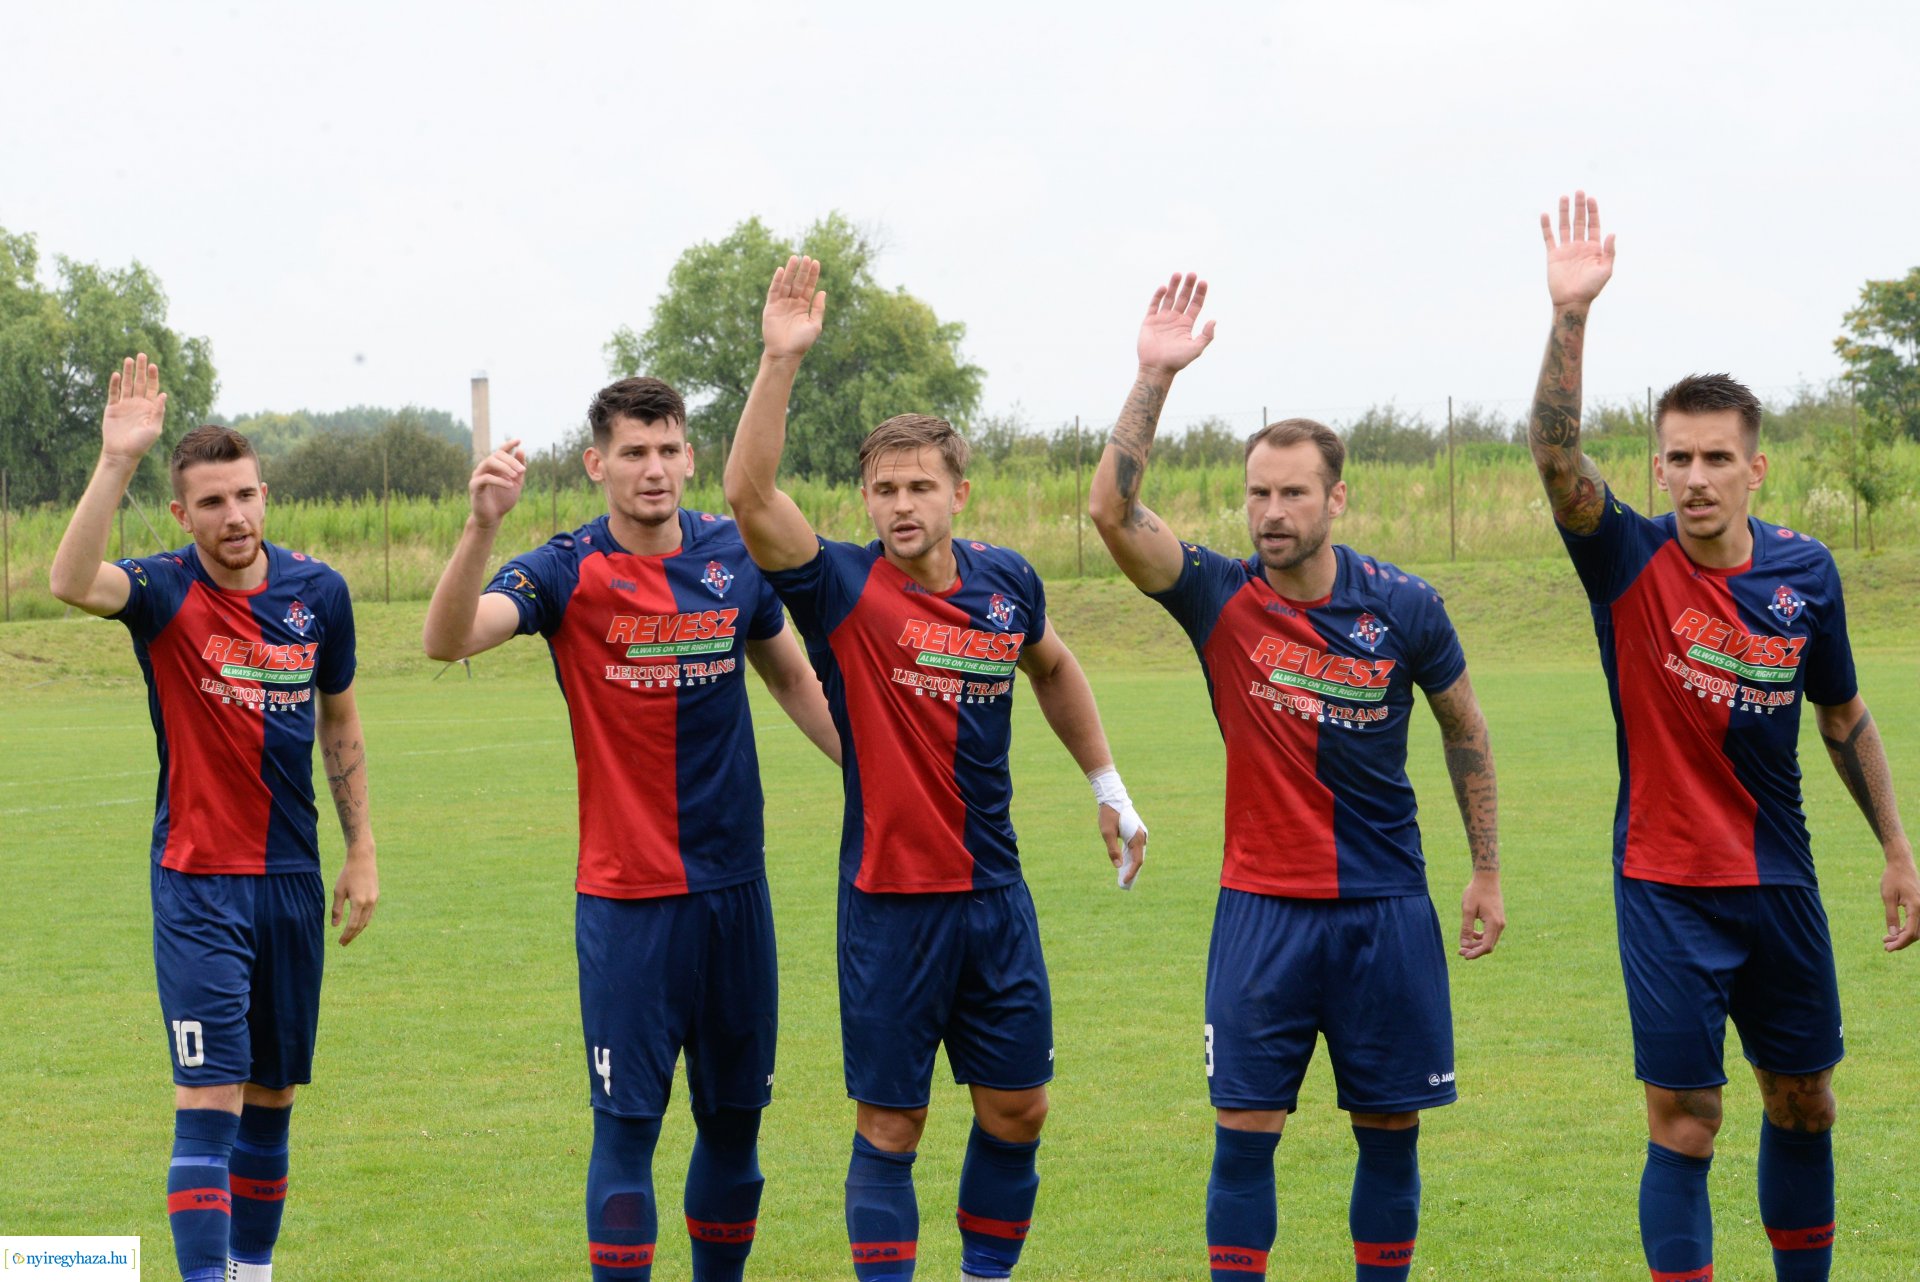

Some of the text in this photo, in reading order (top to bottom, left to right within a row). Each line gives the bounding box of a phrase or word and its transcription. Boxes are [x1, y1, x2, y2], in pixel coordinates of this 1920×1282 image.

[903, 580, 932, 596] JAK
[630, 641, 730, 654] ALWAYS ON THE RIGHT WAY
[223, 667, 251, 677] ALWAYS
[605, 658, 736, 680] LERTON TRANS
[920, 654, 950, 666] ALWAYS
[951, 659, 963, 667] ON
[964, 661, 978, 670] THE
[978, 663, 1000, 672] RIGHT
[1690, 648, 1794, 679] ALWAYS ON THE RIGHT WAY
[200, 678, 311, 704] LERTON TRANS
[630, 676, 717, 688] HUNGARY
[891, 668, 1010, 696] LERTON TRANS
[1273, 672, 1306, 685] ALWAYS
[1307, 681, 1321, 689] ON
[1322, 684, 1337, 693] THE
[1338, 687, 1363, 697] RIGHT
[1665, 653, 1795, 706] LERTON TRANS
[1683, 682, 1775, 715] HUNGARY
[1327, 704, 1389, 722] TRANS
[172, 1020, 204, 1068] 10
[1204, 1023, 1214, 1077] 3
[594, 1046, 611, 1096] 4
